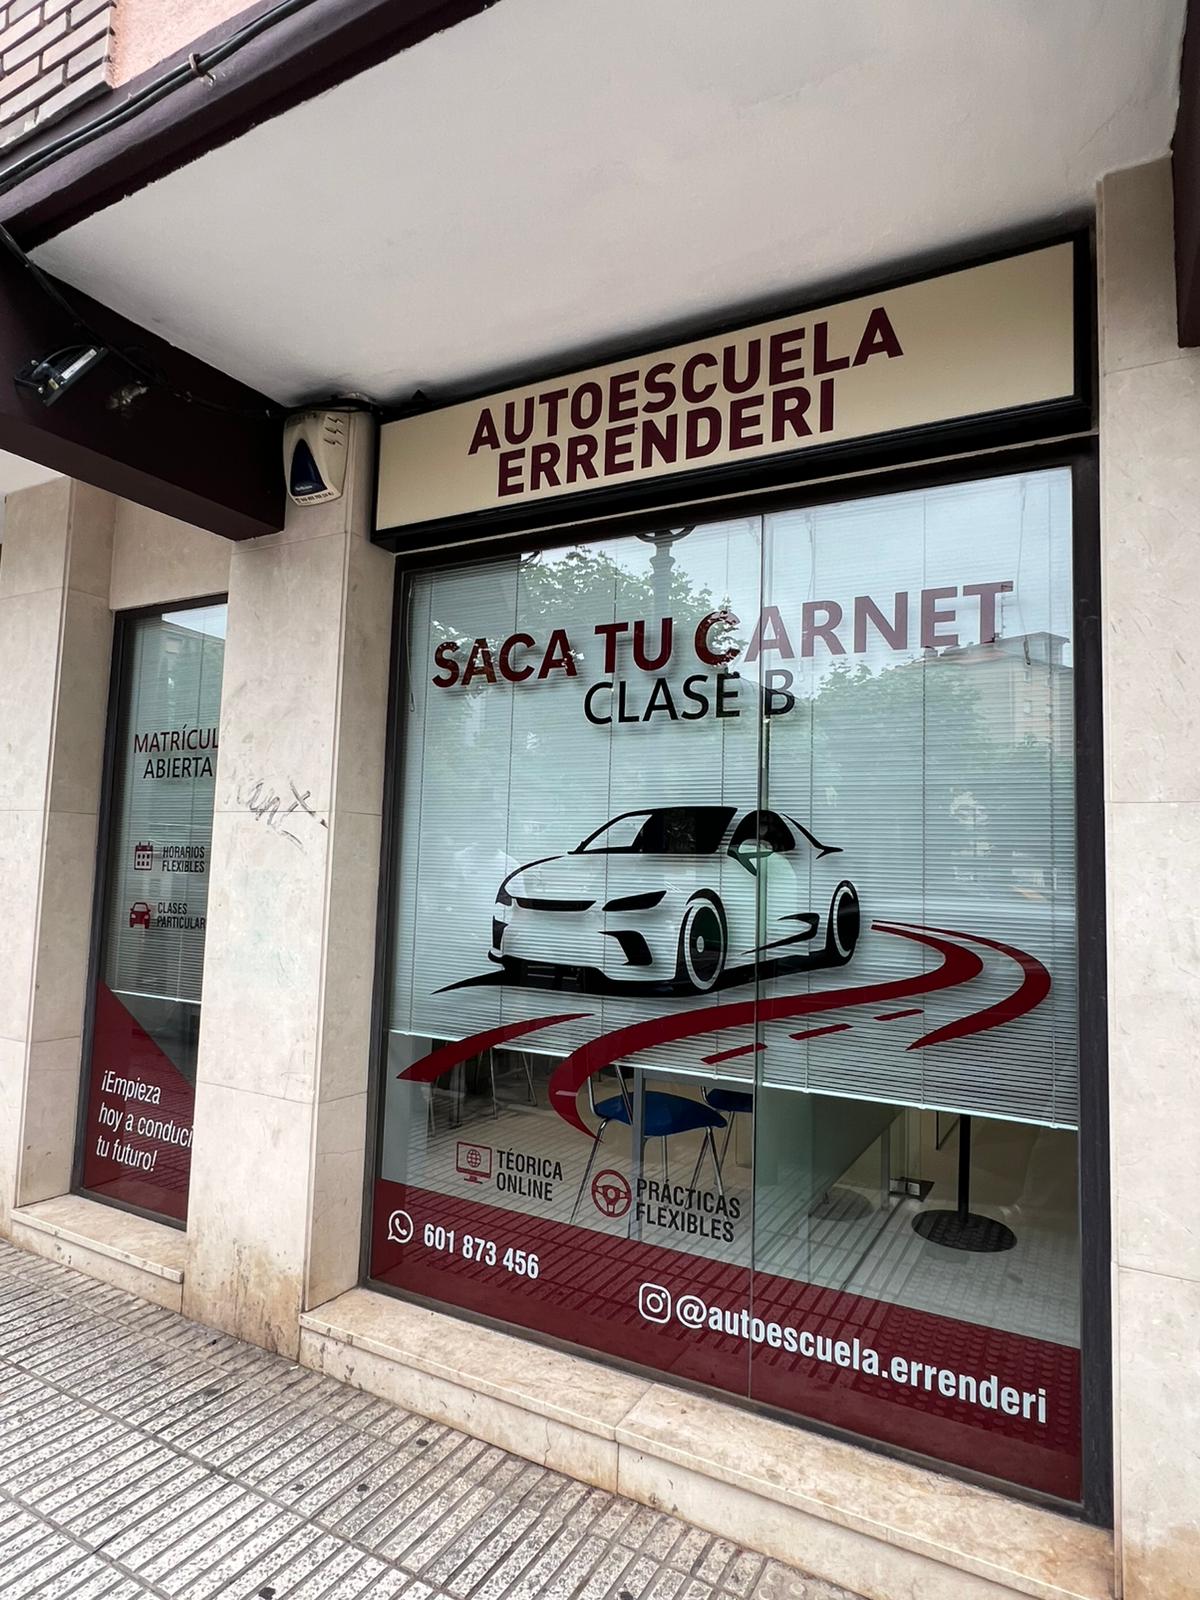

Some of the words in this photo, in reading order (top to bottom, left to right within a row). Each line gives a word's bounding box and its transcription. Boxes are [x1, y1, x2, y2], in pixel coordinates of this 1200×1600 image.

[468, 306, 904, 455] AUTOESCUELA
[498, 378, 834, 497] ERRENDERI
[432, 629, 577, 688] SACA
[595, 617, 672, 674] TU
[694, 580, 1014, 667] CARNET
[584, 672, 741, 725] CLASE
[764, 668, 795, 717] B
[143, 756, 213, 779] ABIERTA
[161, 860, 205, 873] FLEXIBLES
[162, 846, 205, 859] HORARIOS
[157, 902, 188, 915] CLASES
[101, 1070, 161, 1105] ¡Empieza
[98, 1102, 124, 1132] hoy
[125, 1113, 134, 1132] a
[96, 1135, 110, 1157] tu
[111, 1138, 158, 1172] futuro!
[497, 1147, 563, 1181] TÉORICA
[496, 1171, 553, 1202] ONLINE
[636, 1178, 741, 1220] PRÁCTICAS
[635, 1205, 735, 1244] FLEXIBLES
[423, 1223, 455, 1254] 601
[462, 1234, 497, 1266] 873
[503, 1247, 540, 1280] 456
[676, 1294, 1047, 1423] @autoescuela.errenderi
